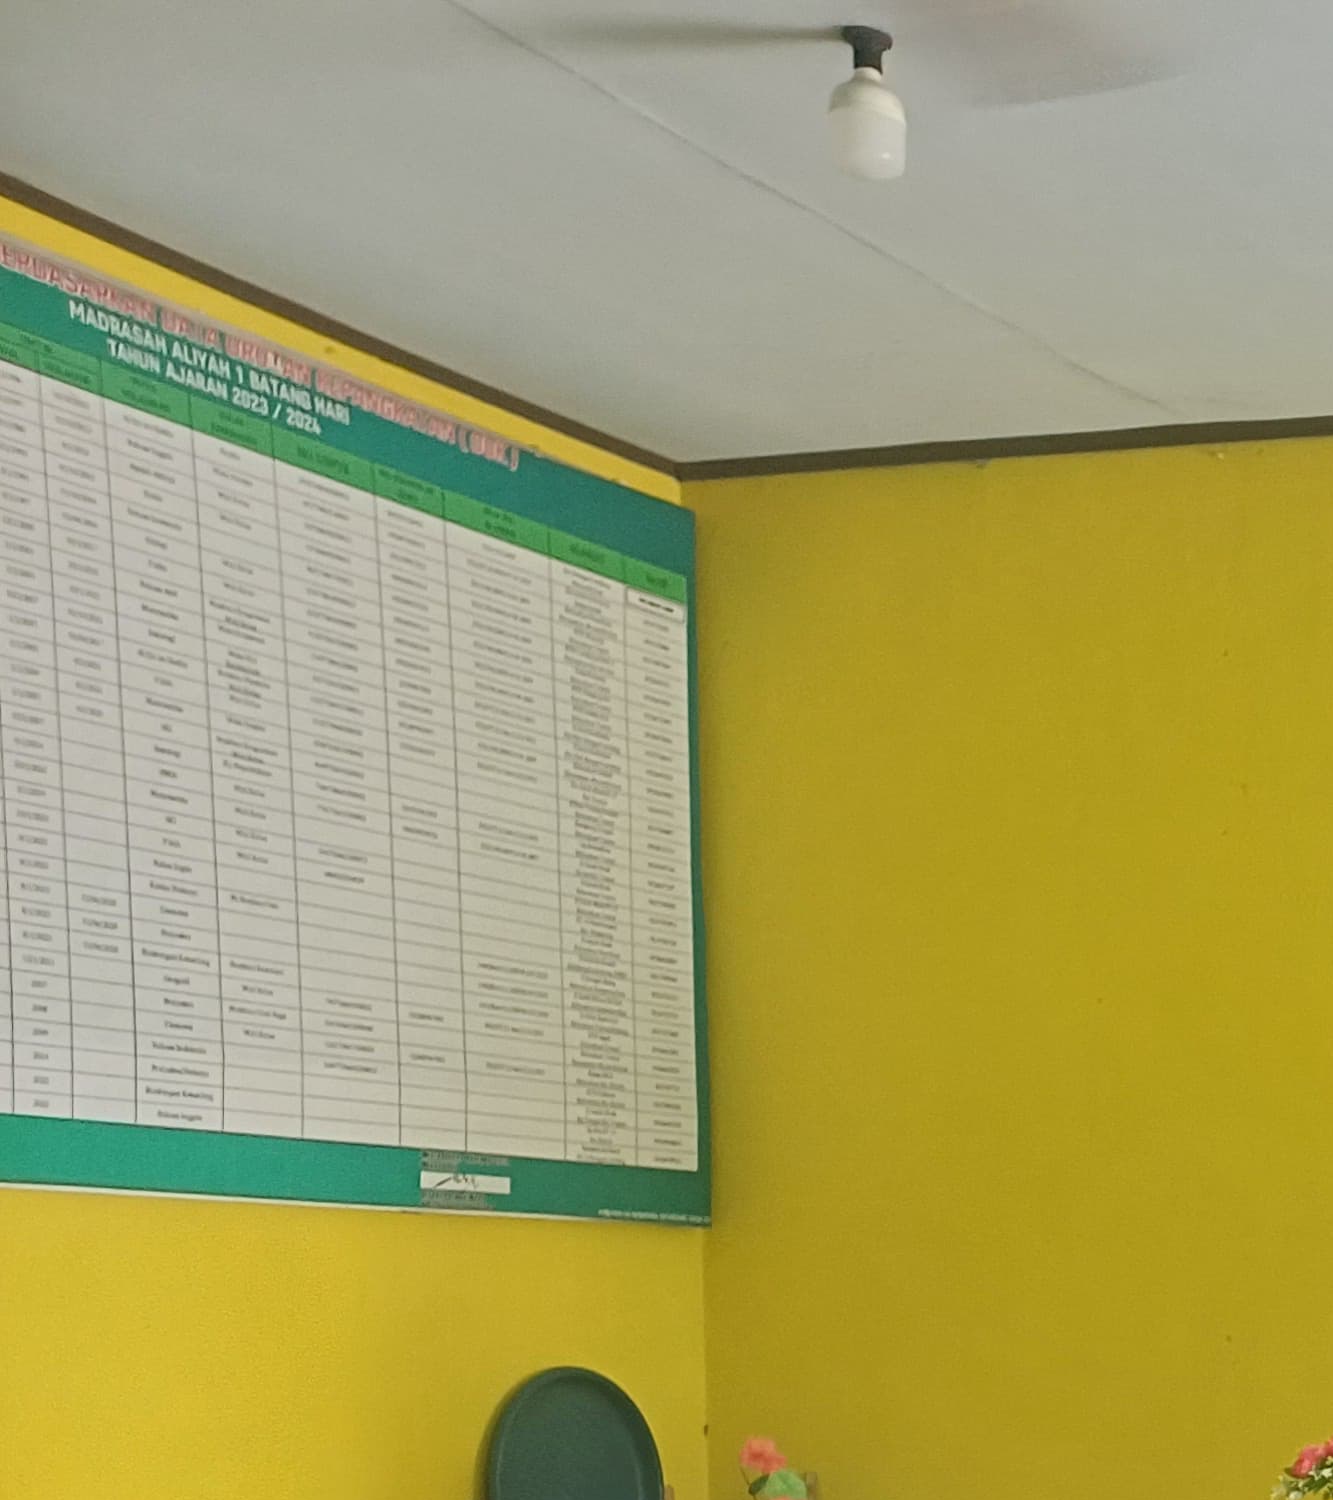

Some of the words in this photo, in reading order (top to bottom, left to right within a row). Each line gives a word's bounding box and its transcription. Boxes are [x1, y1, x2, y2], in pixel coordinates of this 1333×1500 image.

[0, 244, 158, 328] ERDASARKAN
[69, 299, 167, 355] MADRASAH
[172, 340, 231, 381] ALIYAH
[236, 365, 244, 384] 1
[249, 369, 312, 410] BATANG
[314, 398, 350, 426] HARI
[106, 338, 161, 374] TAHUN
[165, 360, 229, 401] AJARAN
[232, 386, 270, 416] 2023
[286, 407, 322, 436] 2024
